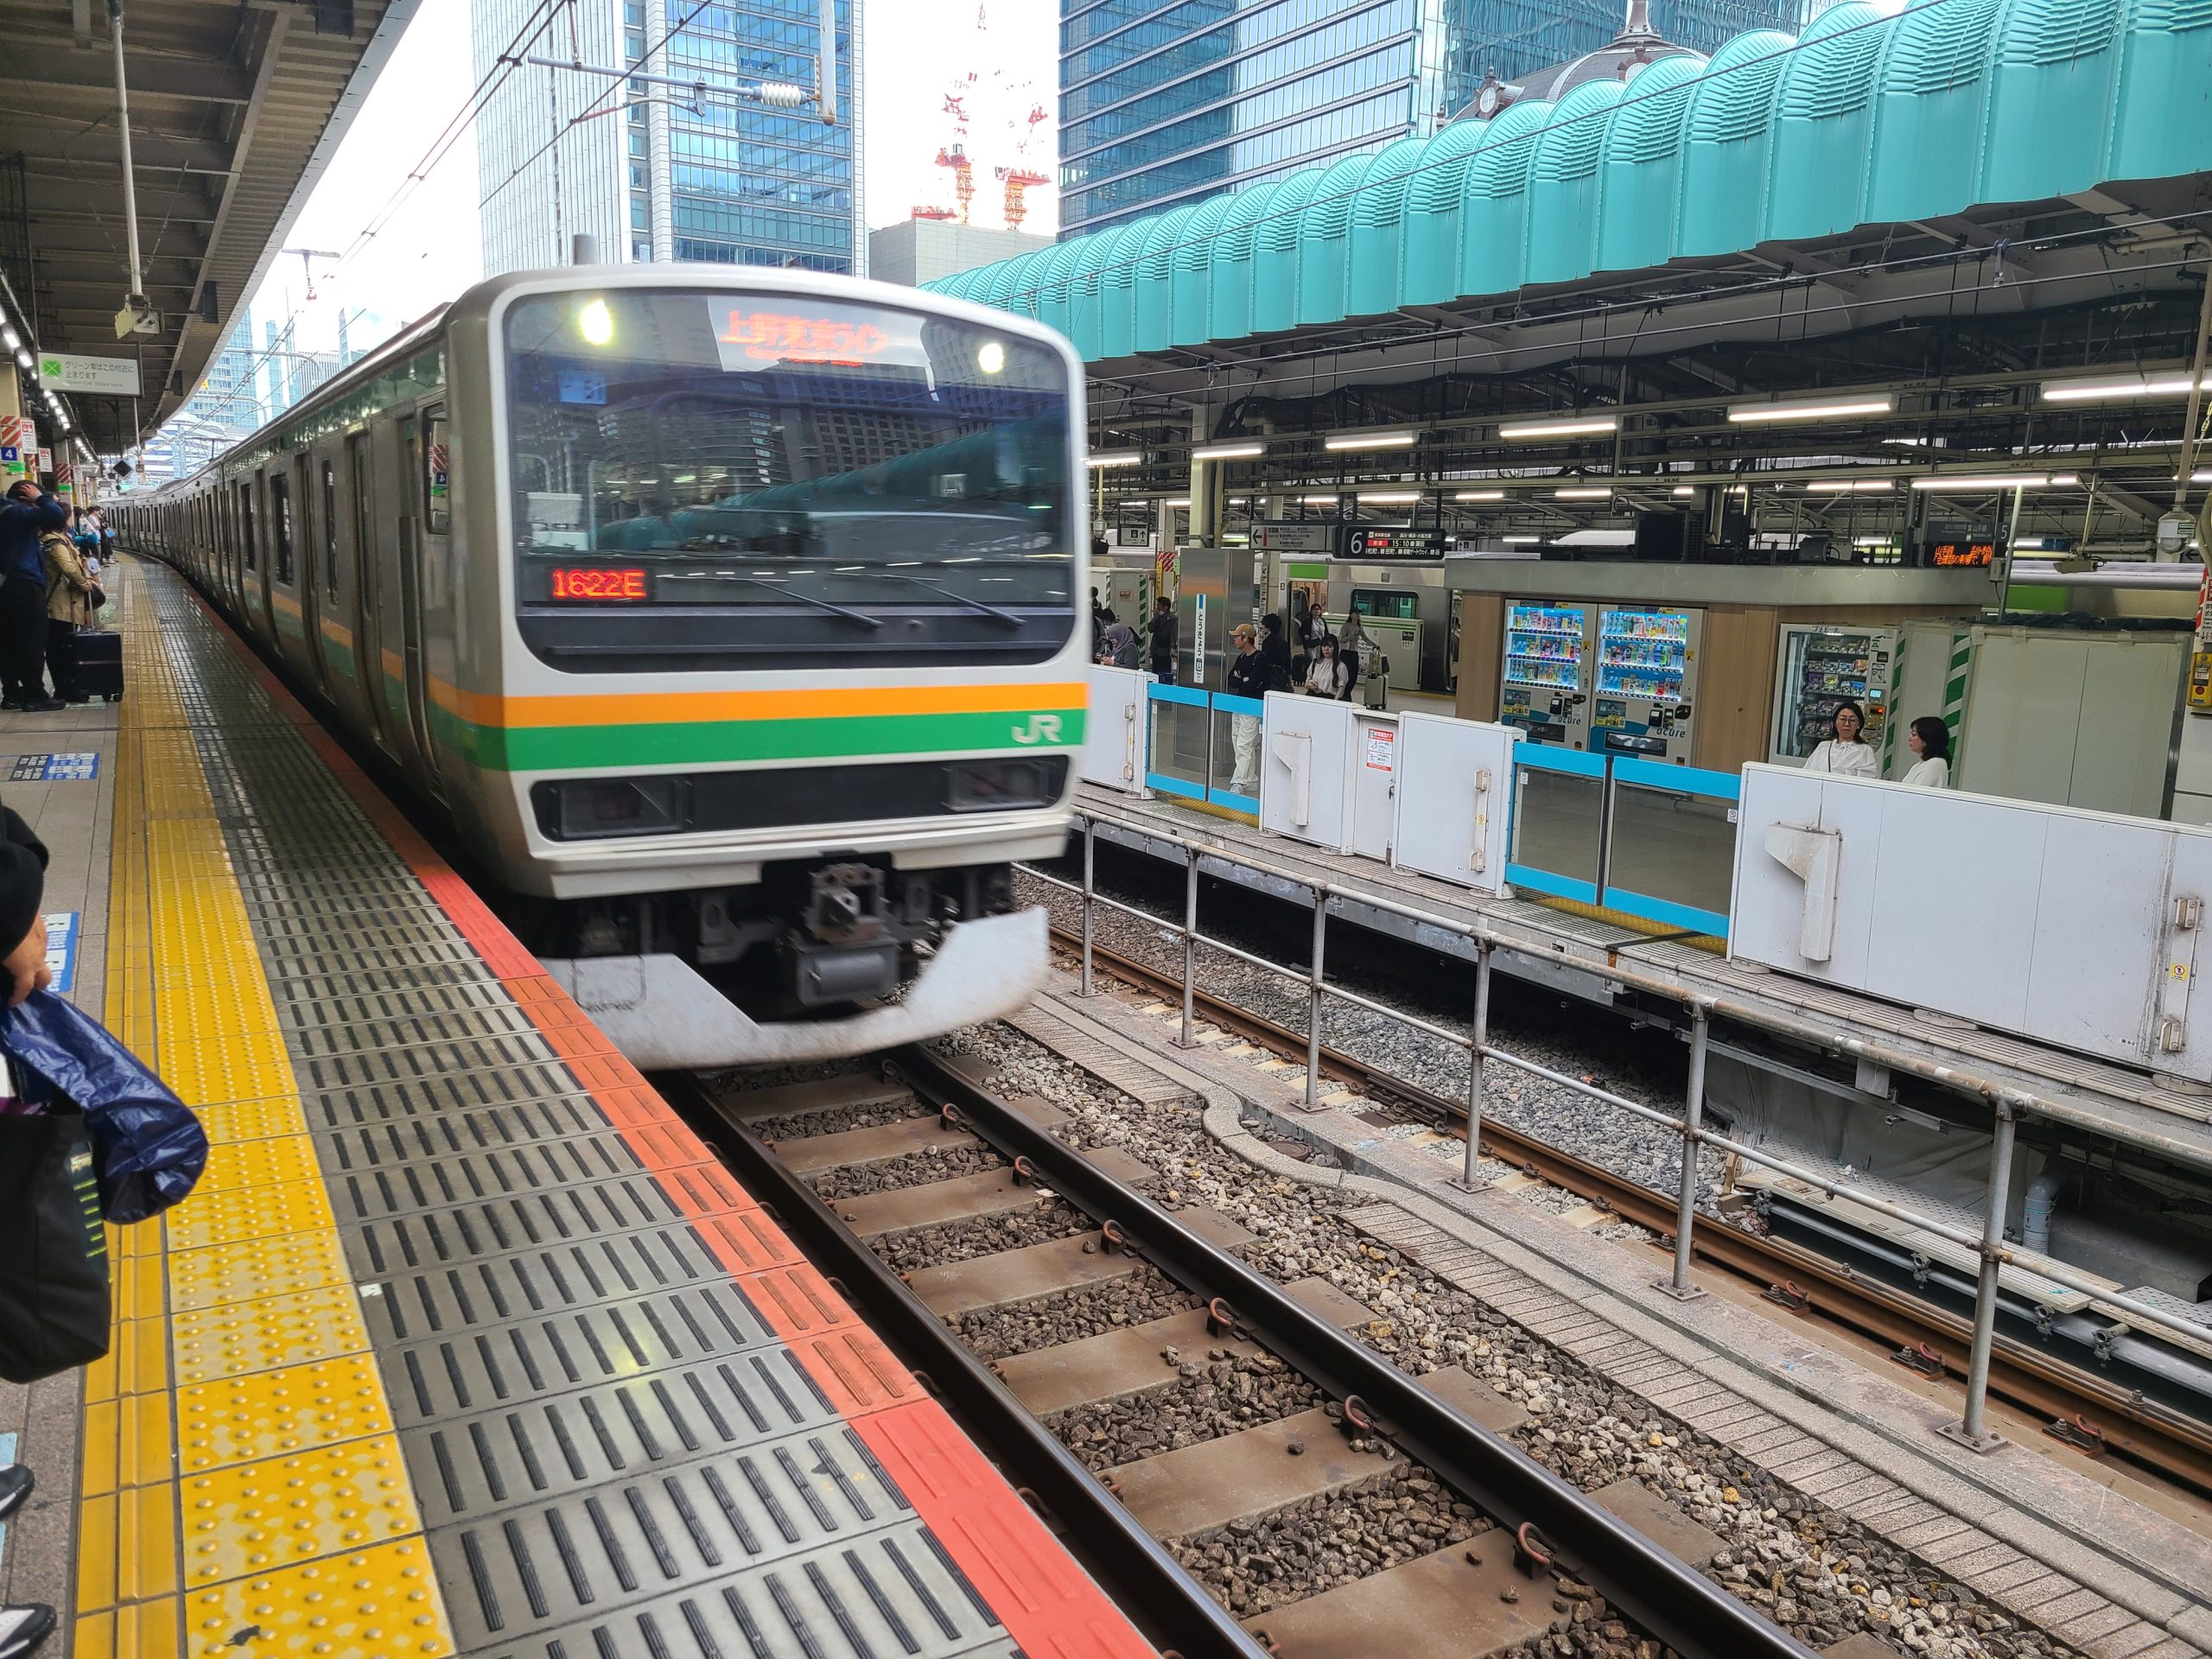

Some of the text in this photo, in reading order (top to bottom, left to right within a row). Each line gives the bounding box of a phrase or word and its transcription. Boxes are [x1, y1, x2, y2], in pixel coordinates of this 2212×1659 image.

[65, 361, 134, 372] グリーン車はこの付近に
[66, 372, 98, 380] 止まります
[5, 449, 14, 459] 4
[2000, 524, 2008, 540] 5
[1351, 531, 1363, 554] 6
[553, 569, 647, 599] 1622E
[1557, 715, 1581, 725] acure
[1011, 715, 1063, 744] JR
[1656, 728, 1686, 738] acure
